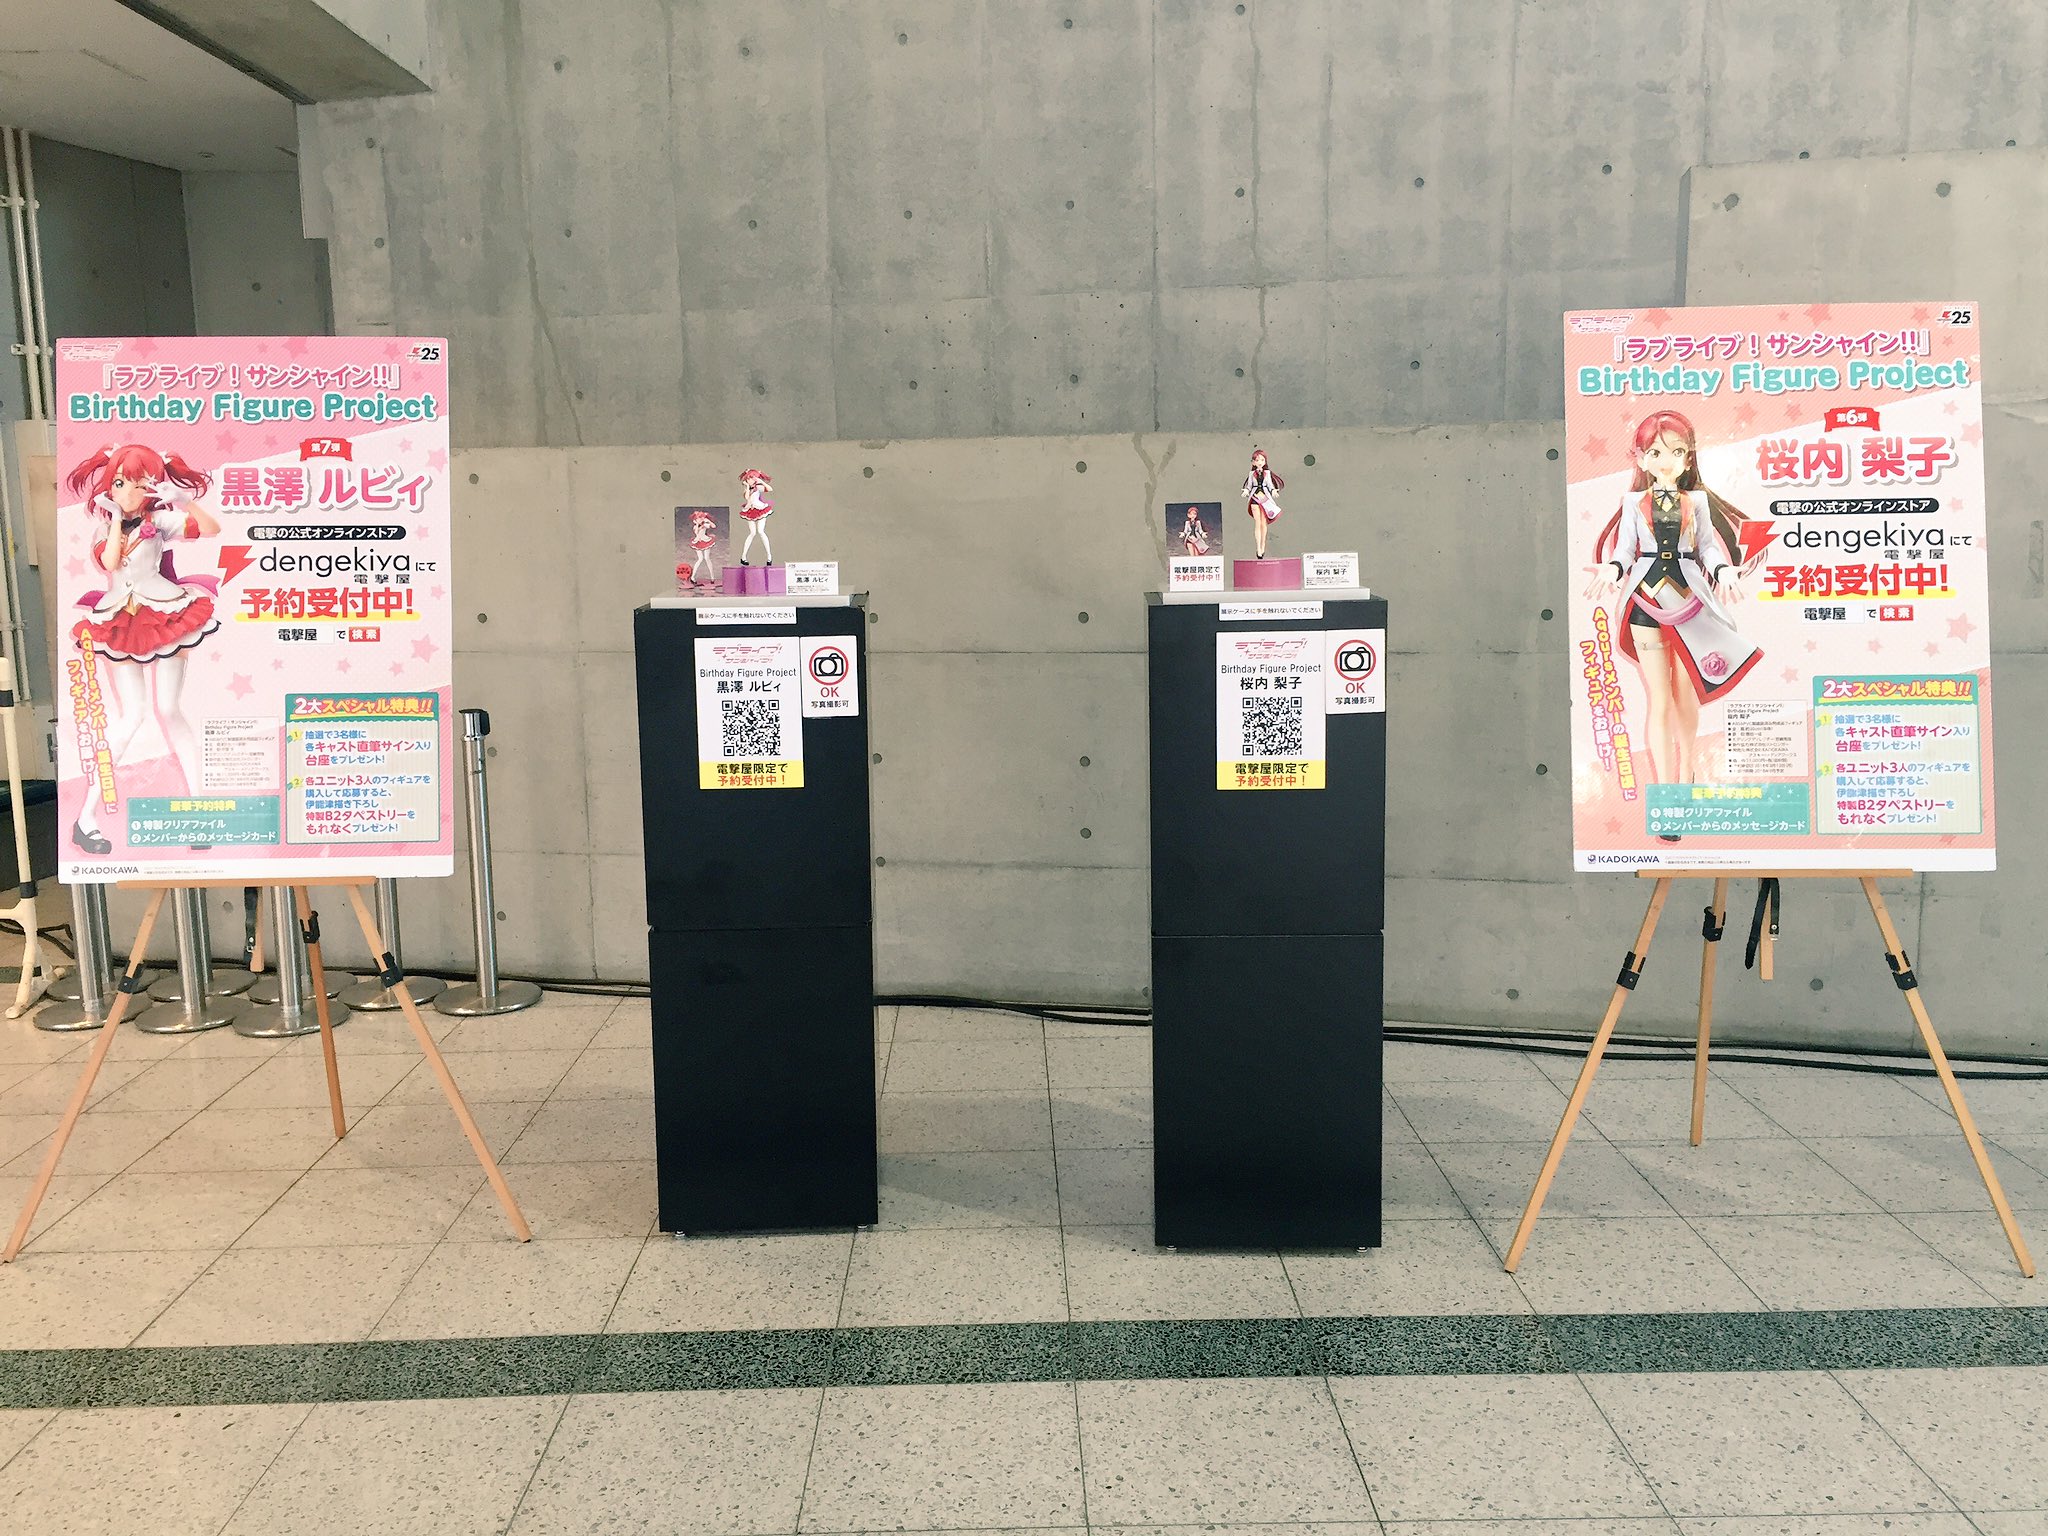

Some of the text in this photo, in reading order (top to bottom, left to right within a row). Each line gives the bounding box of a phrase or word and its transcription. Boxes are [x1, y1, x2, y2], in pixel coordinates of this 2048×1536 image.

[1580, 359, 1966, 394] Birthday Figure Project
[70, 392, 435, 422] Birthday Figure Project
[1756, 436, 1950, 480] 桜内 梨子
[220, 464, 425, 506] 黒澤 ルビィ
[1776, 499, 1931, 514] 電撃の公式オンラインストア
[253, 526, 399, 540] 電撃の公式オンラインストア
[1783, 520, 1973, 553] dengekiya にて
[259, 546, 436, 578] dengekiya にて
[1763, 563, 1948, 598] 予約受付中!
[240, 586, 413, 619] 予約受付中!
[700, 667, 796, 679] Birthday Figure Project
[1221, 663, 1321, 675] Birthday Figure Project
[749, 680, 781, 692] ルビィ
[1240, 677, 1302, 690] 桜内 梨子
[1345, 682, 1365, 694] OK
[820, 687, 839, 698] OK
[716, 762, 788, 774] 電撃屋限定で
[1234, 763, 1309, 775] 電撃屋限定で
[1598, 855, 1660, 864] KADOKAWA
[82, 866, 139, 875] KADOKAWA
